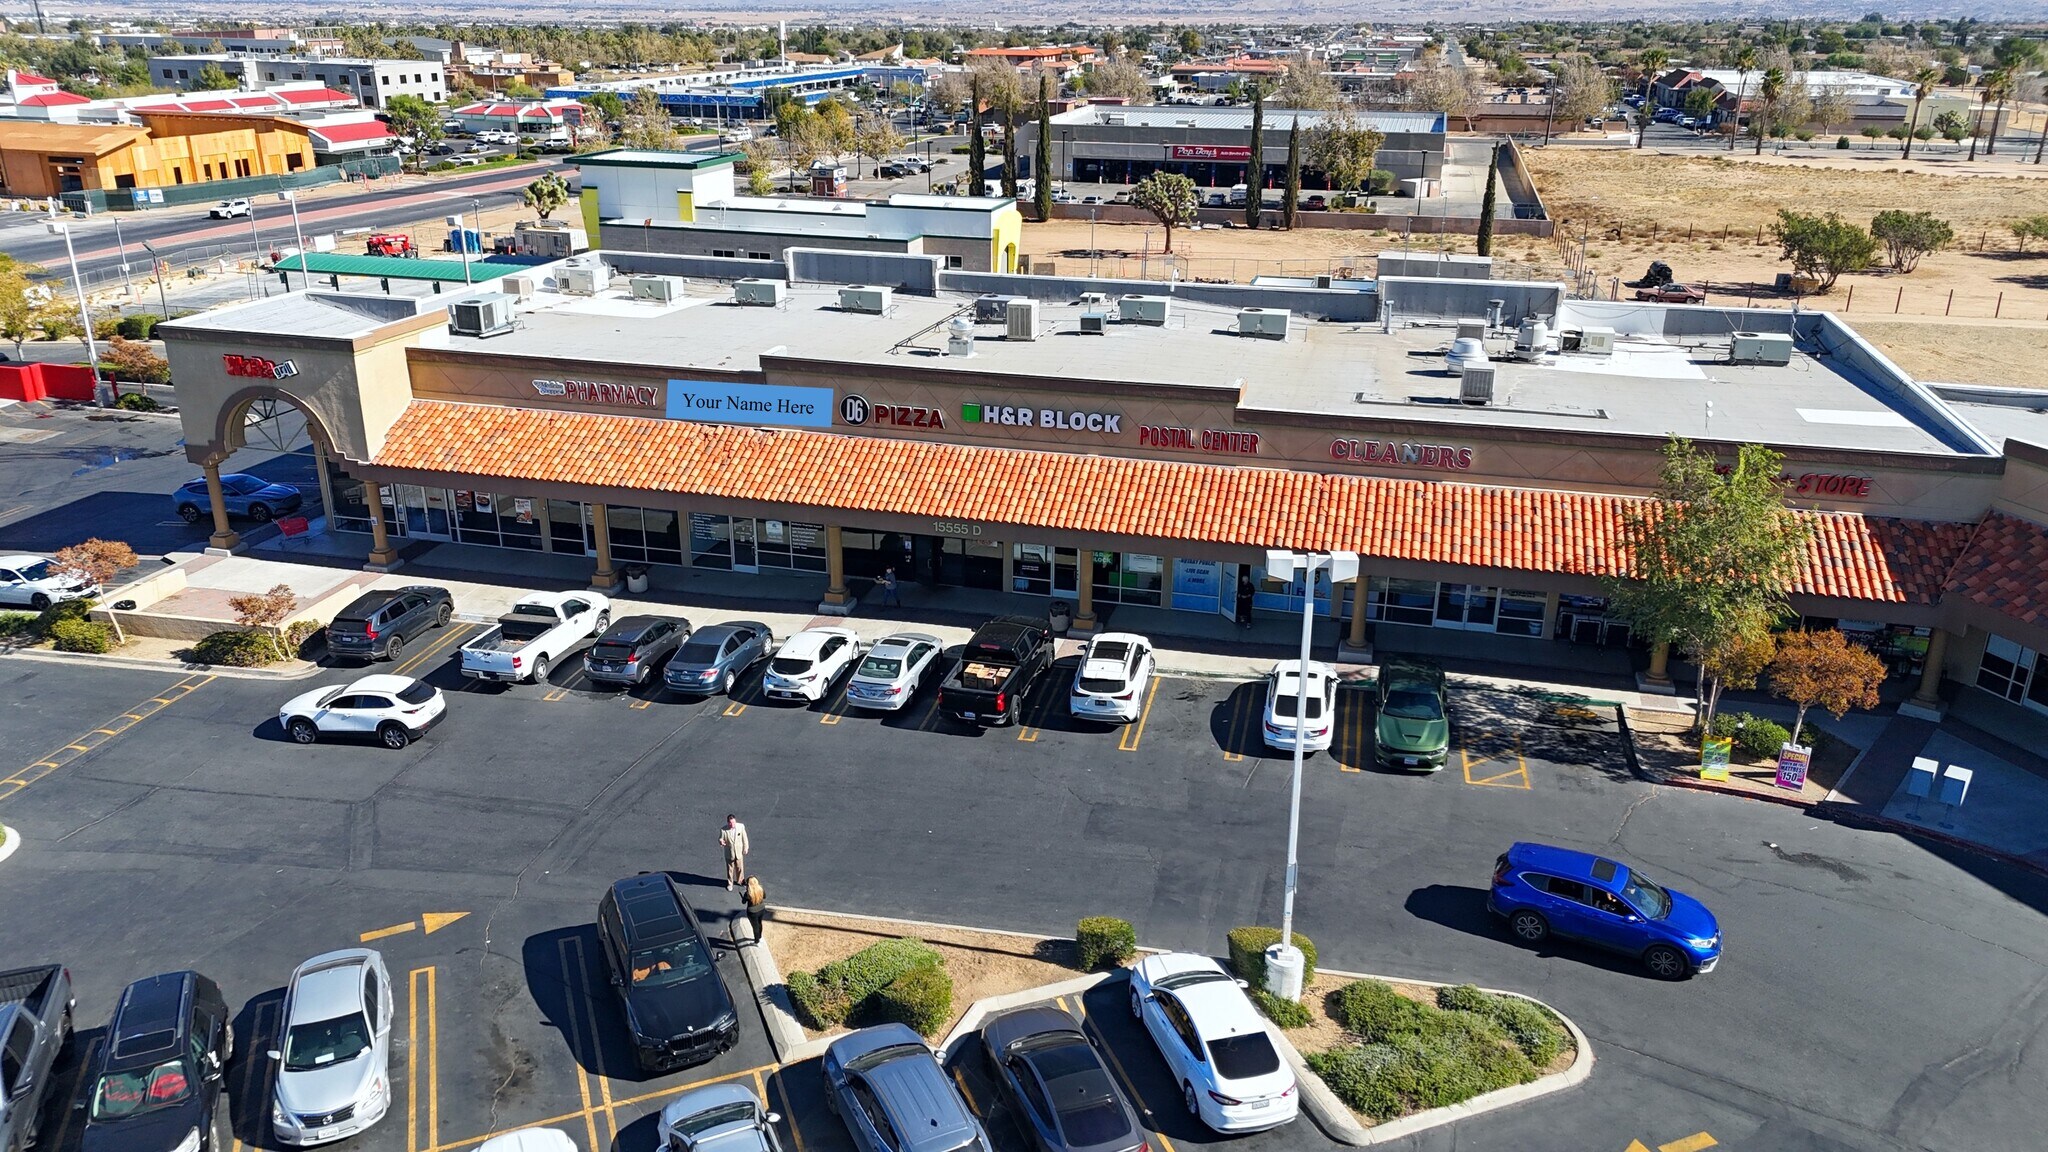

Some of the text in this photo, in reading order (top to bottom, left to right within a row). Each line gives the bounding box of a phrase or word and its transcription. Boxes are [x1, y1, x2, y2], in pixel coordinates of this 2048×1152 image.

[1177, 147, 1217, 158] Pep Boys
[273, 360, 297, 379] grill
[566, 380, 658, 406] PHARMACY
[683, 393, 815, 415] Your Name Here
[846, 398, 864, 422] D6
[874, 403, 946, 430] PIZZA
[983, 405, 1121, 433] H&R BLOCK
[1140, 426, 1259, 454] POSTAL CENTER
[1329, 438, 1472, 469] CLEANERS
[1797, 473, 1873, 498] STORE
[933, 521, 982, 536] 15555 D
[1782, 752, 1808, 762] SPECIAL
